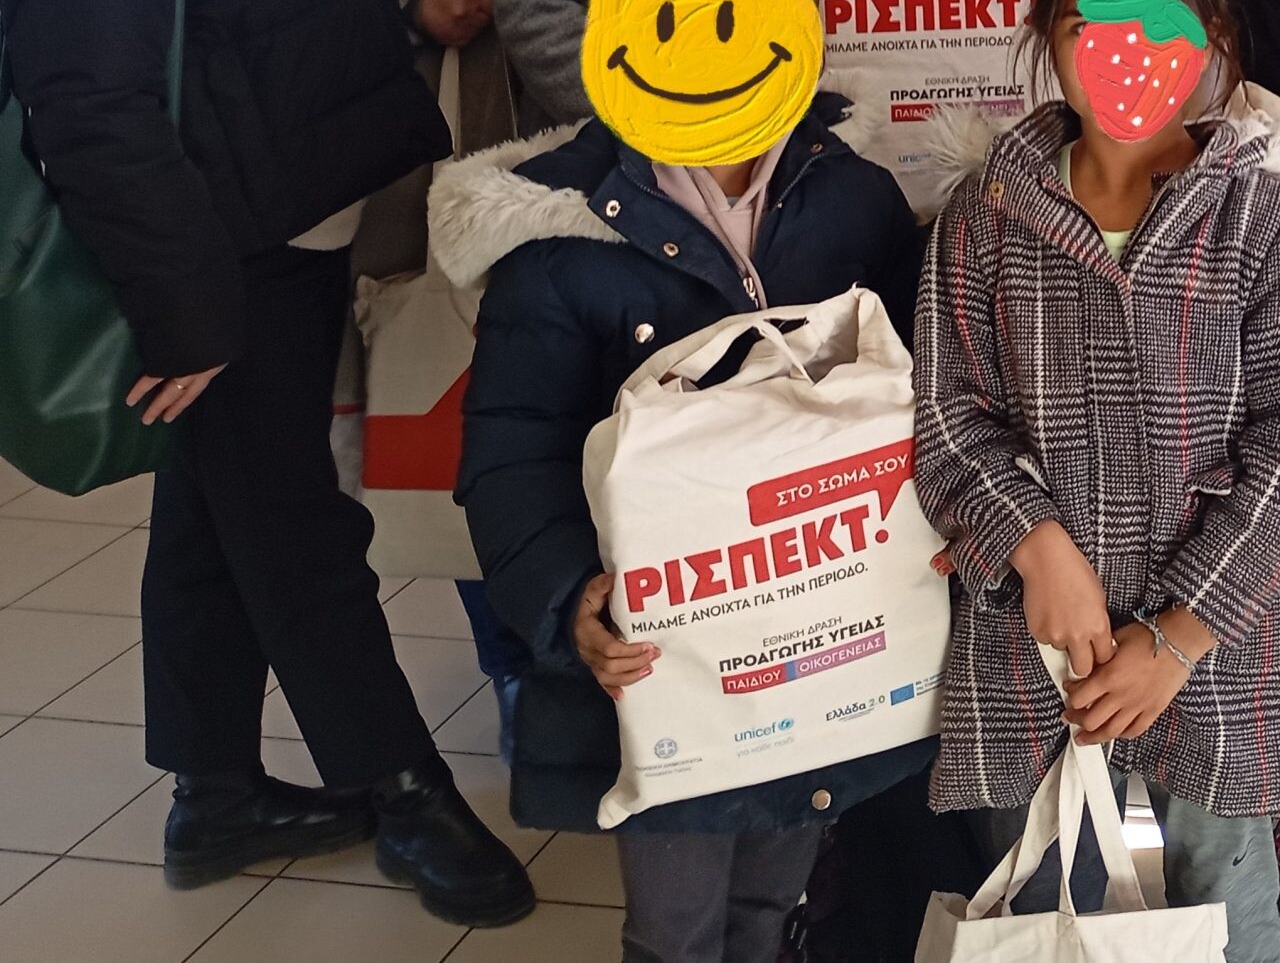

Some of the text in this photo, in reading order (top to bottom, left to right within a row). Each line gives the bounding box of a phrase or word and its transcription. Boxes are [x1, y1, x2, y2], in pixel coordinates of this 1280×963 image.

[826, 41, 868, 54] ΜΙΛΑΜΕ
[871, 39, 918, 52] ΑΝΟΙΧΤΑ
[921, 38, 937, 50] ΓΙΑ
[939, 37, 962, 49] ΤΗΝ
[890, 85, 1025, 101] ΠΡΟΑΓΩΓΗΣ ΥΓΕΙΑΣ
[895, 107, 934, 119] ΠΑΙΔΙΟ
[776, 453, 909, 508] ΣΤΟ ΣΩΜΑ ΣΟΥ
[631, 564, 869, 634] ΜΙΛΑΜΕ ΑΝΟΙΧΤΑ ΓΙΑ ΤΗΝ ΠΕΡΙΟΔΟ.
[719, 614, 885, 673] ΠΡΟΑΓΩΓΗΣ ΥΓΕΙΑΣ
[762, 616, 842, 647] ΕΘΝΙΚΗ ΔΡΑΣΗ
[726, 636, 882, 690] ΠΑΙΔΙΟΥ ΟΙΚΟΓΕΝΕΙΑΣ
[826, 701, 867, 722] Ελλάδα
[734, 721, 777, 742] unicef
